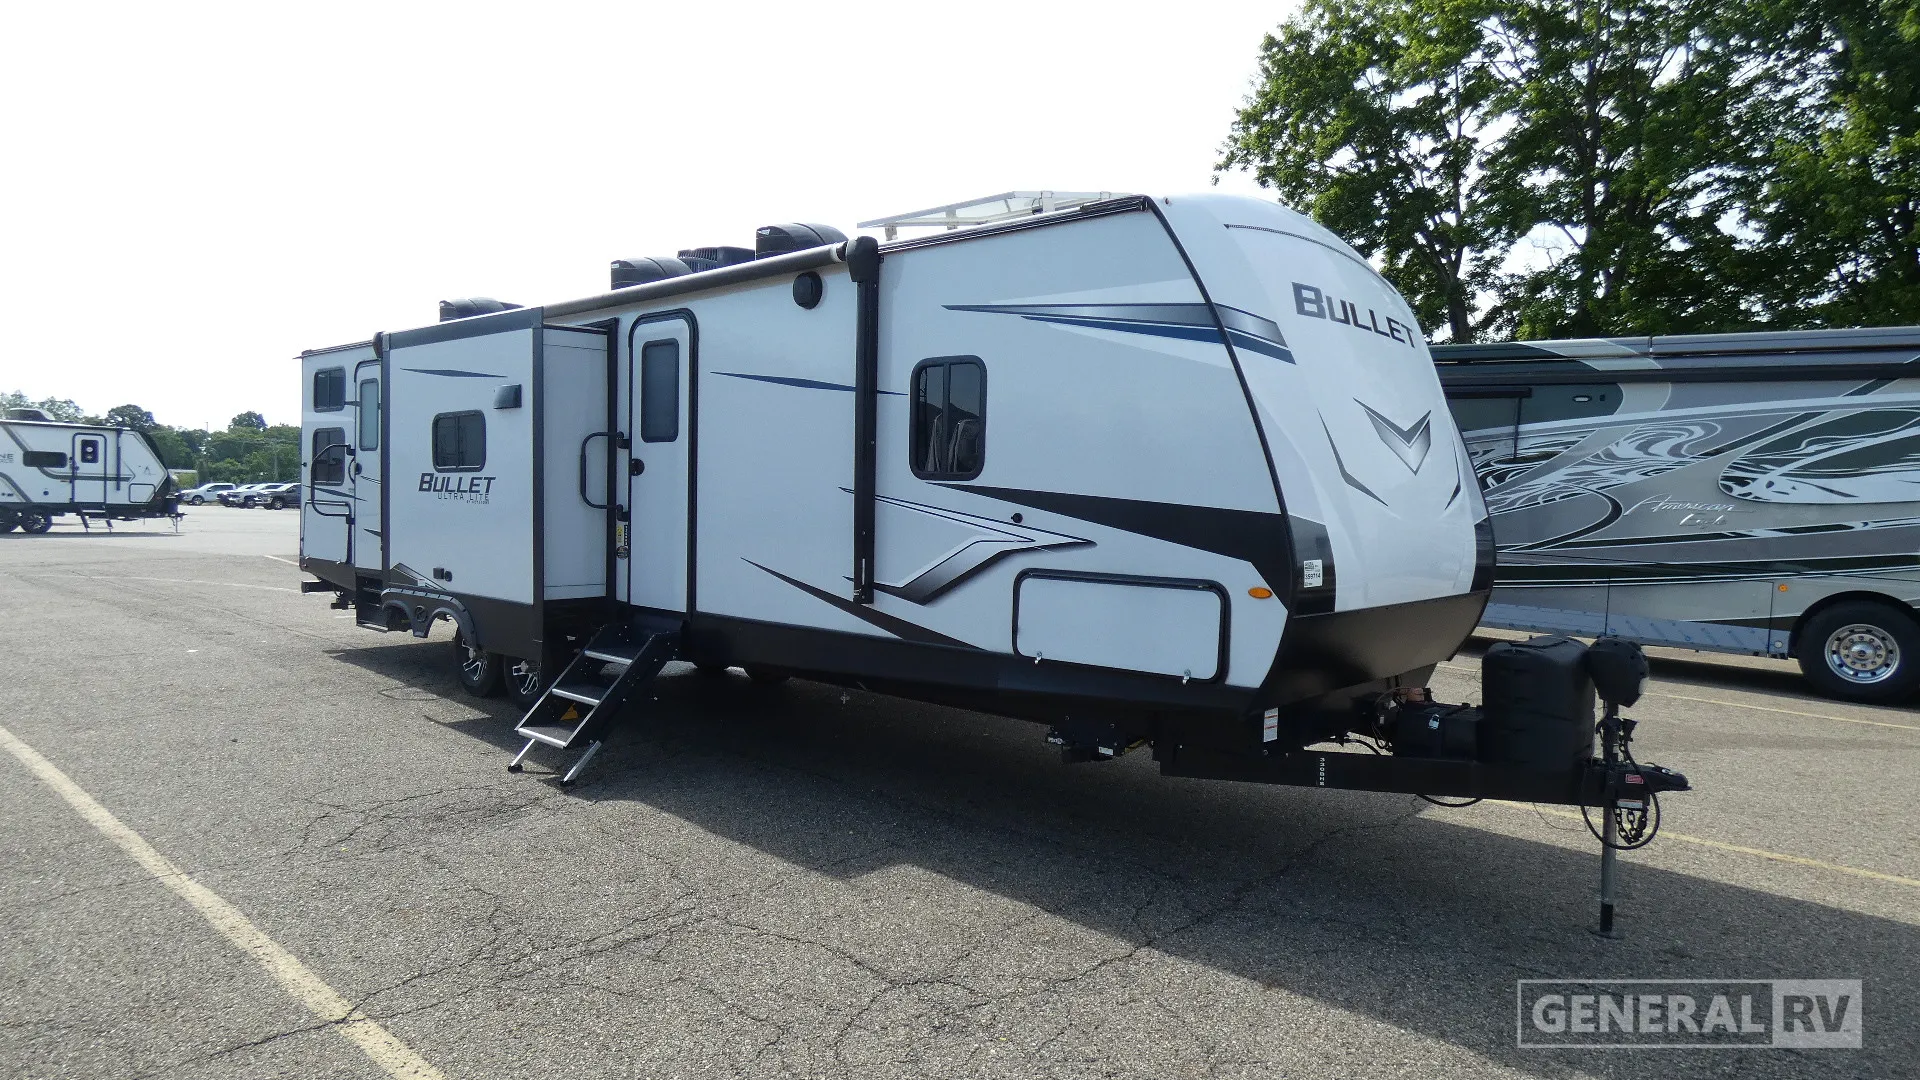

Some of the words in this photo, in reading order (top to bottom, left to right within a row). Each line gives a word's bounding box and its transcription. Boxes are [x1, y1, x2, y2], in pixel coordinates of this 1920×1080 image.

[1291, 281, 1416, 349] BULLET
[418, 472, 497, 494] BULLET
[437, 492, 464, 501] ULTRA
[469, 493, 489, 501] LITE
